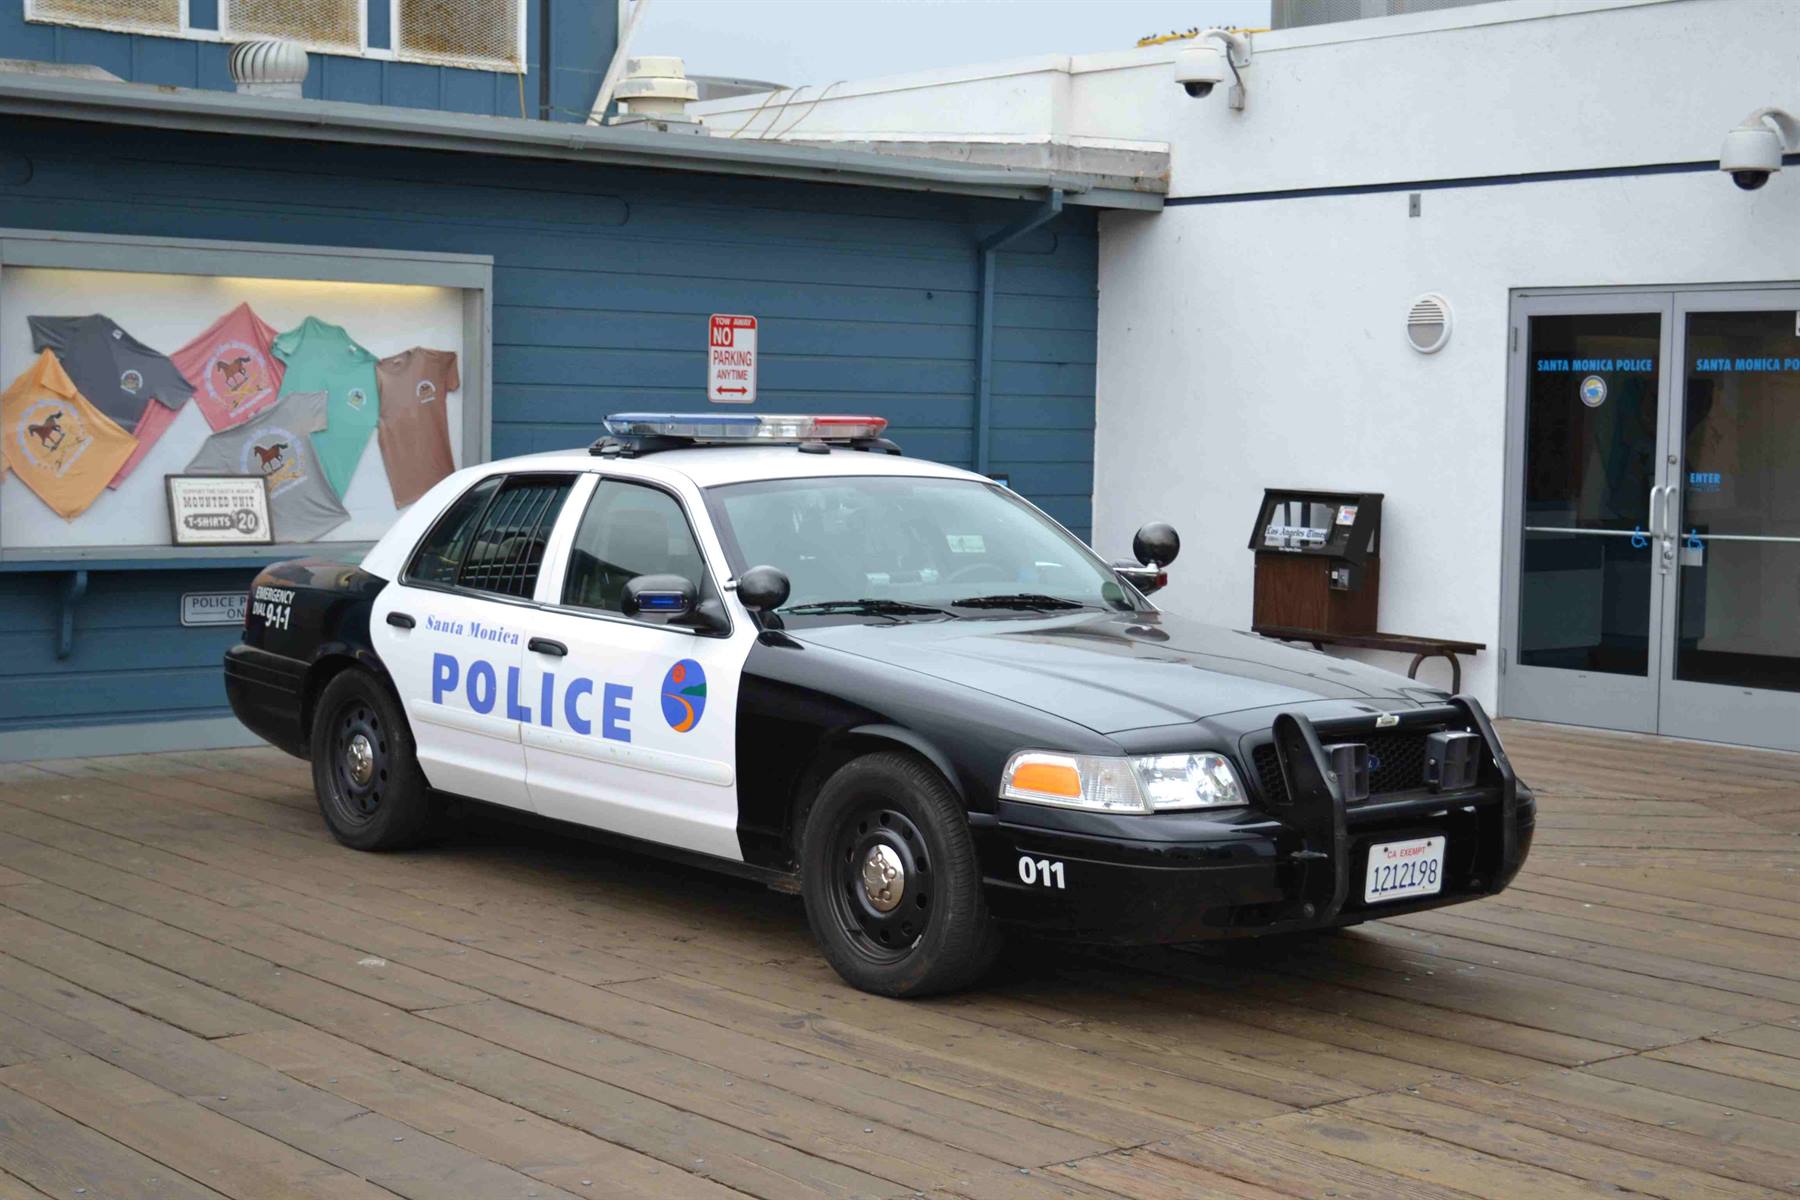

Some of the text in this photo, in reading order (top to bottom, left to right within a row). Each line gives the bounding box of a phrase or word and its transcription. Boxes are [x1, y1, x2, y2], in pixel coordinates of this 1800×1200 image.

[716, 317, 731, 325] TOW
[713, 327, 731, 345] NO
[713, 350, 752, 366] PARKING
[1537, 359, 1653, 372] SANTA MONICA POLICE
[1696, 358, 1732, 372] SANTA
[1735, 358, 1780, 372] MONICA
[717, 369, 748, 380] ANYTIME
[1689, 472, 1721, 484] ENTER
[183, 496, 254, 508] MOUNTED UNIT
[187, 515, 231, 528] T-SHIRTS
[1266, 527, 1279, 535] Los
[255, 586, 295, 604] EMERGENCY
[192, 596, 235, 608] POLICE
[226, 609, 245, 619] ON
[252, 602, 266, 616] DIAL
[425, 615, 519, 645] Santa Monica
[432, 652, 633, 743] POLICE
[1387, 846, 1426, 859] CA EXEMPT
[1018, 856, 1065, 889] 011
[1371, 858, 1438, 893] 1212198
